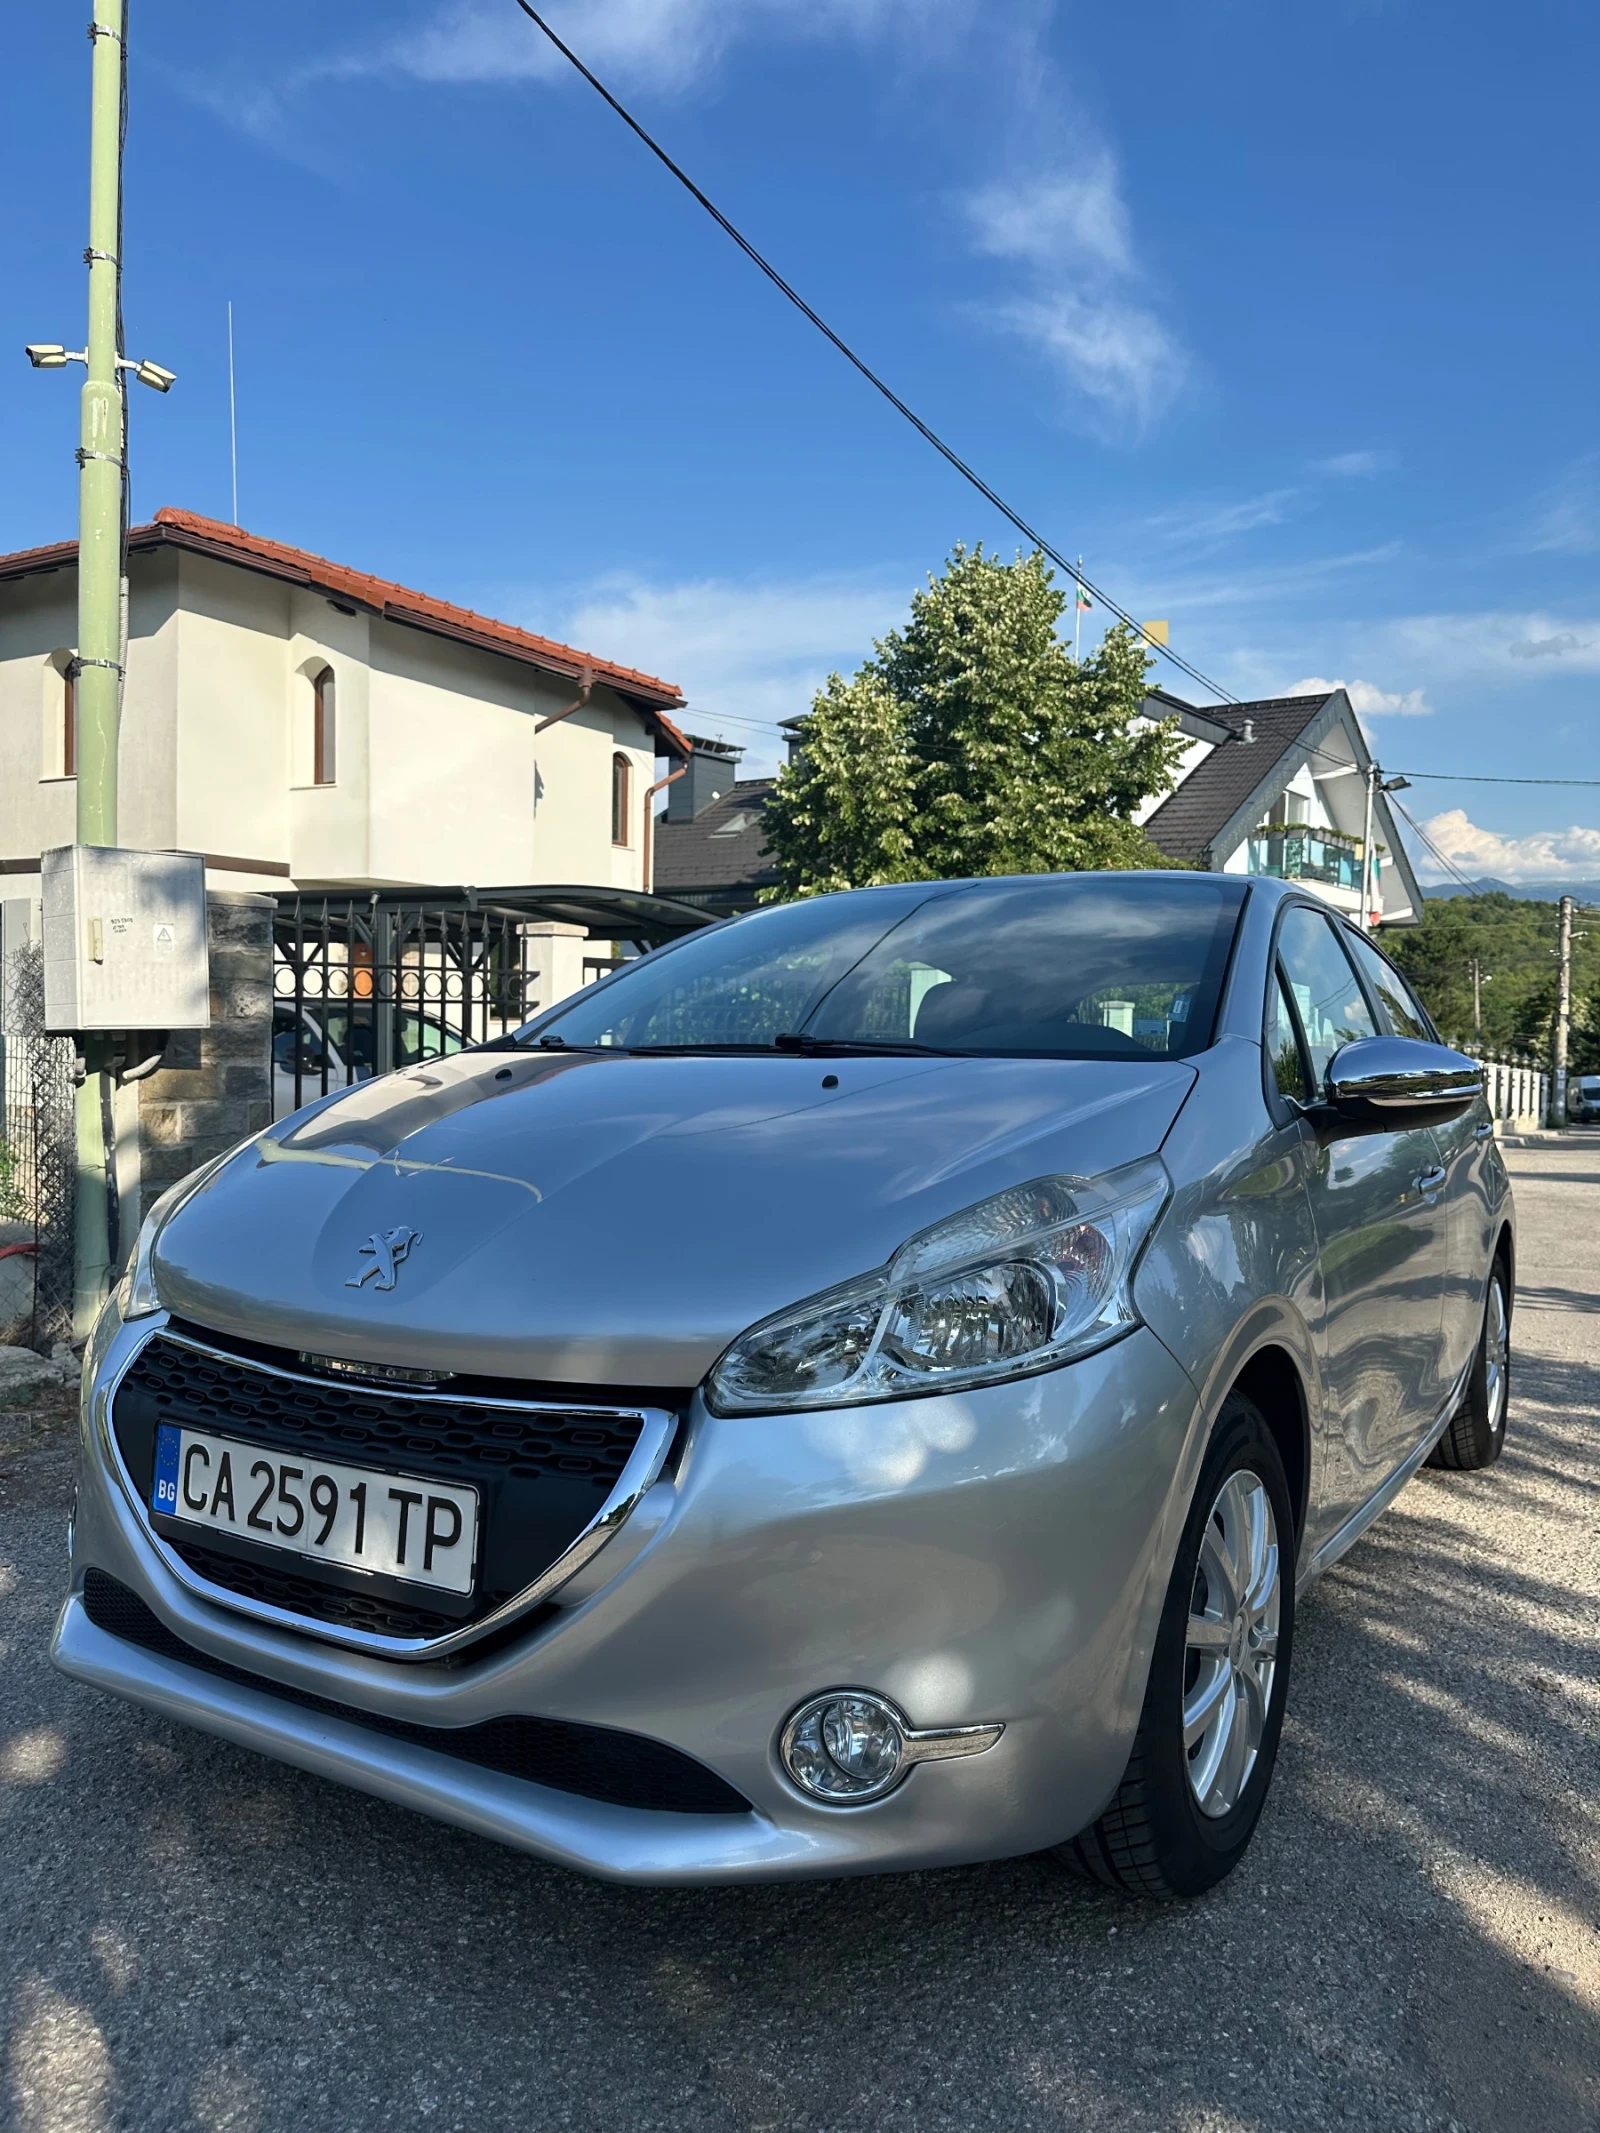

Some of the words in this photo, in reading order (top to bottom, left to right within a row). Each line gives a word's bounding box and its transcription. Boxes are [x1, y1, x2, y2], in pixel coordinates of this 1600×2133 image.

[158, 1479, 175, 1501] BG
[183, 1443, 235, 1521] CA
[247, 1460, 367, 1554] 2591
[388, 1487, 463, 1571] TP
